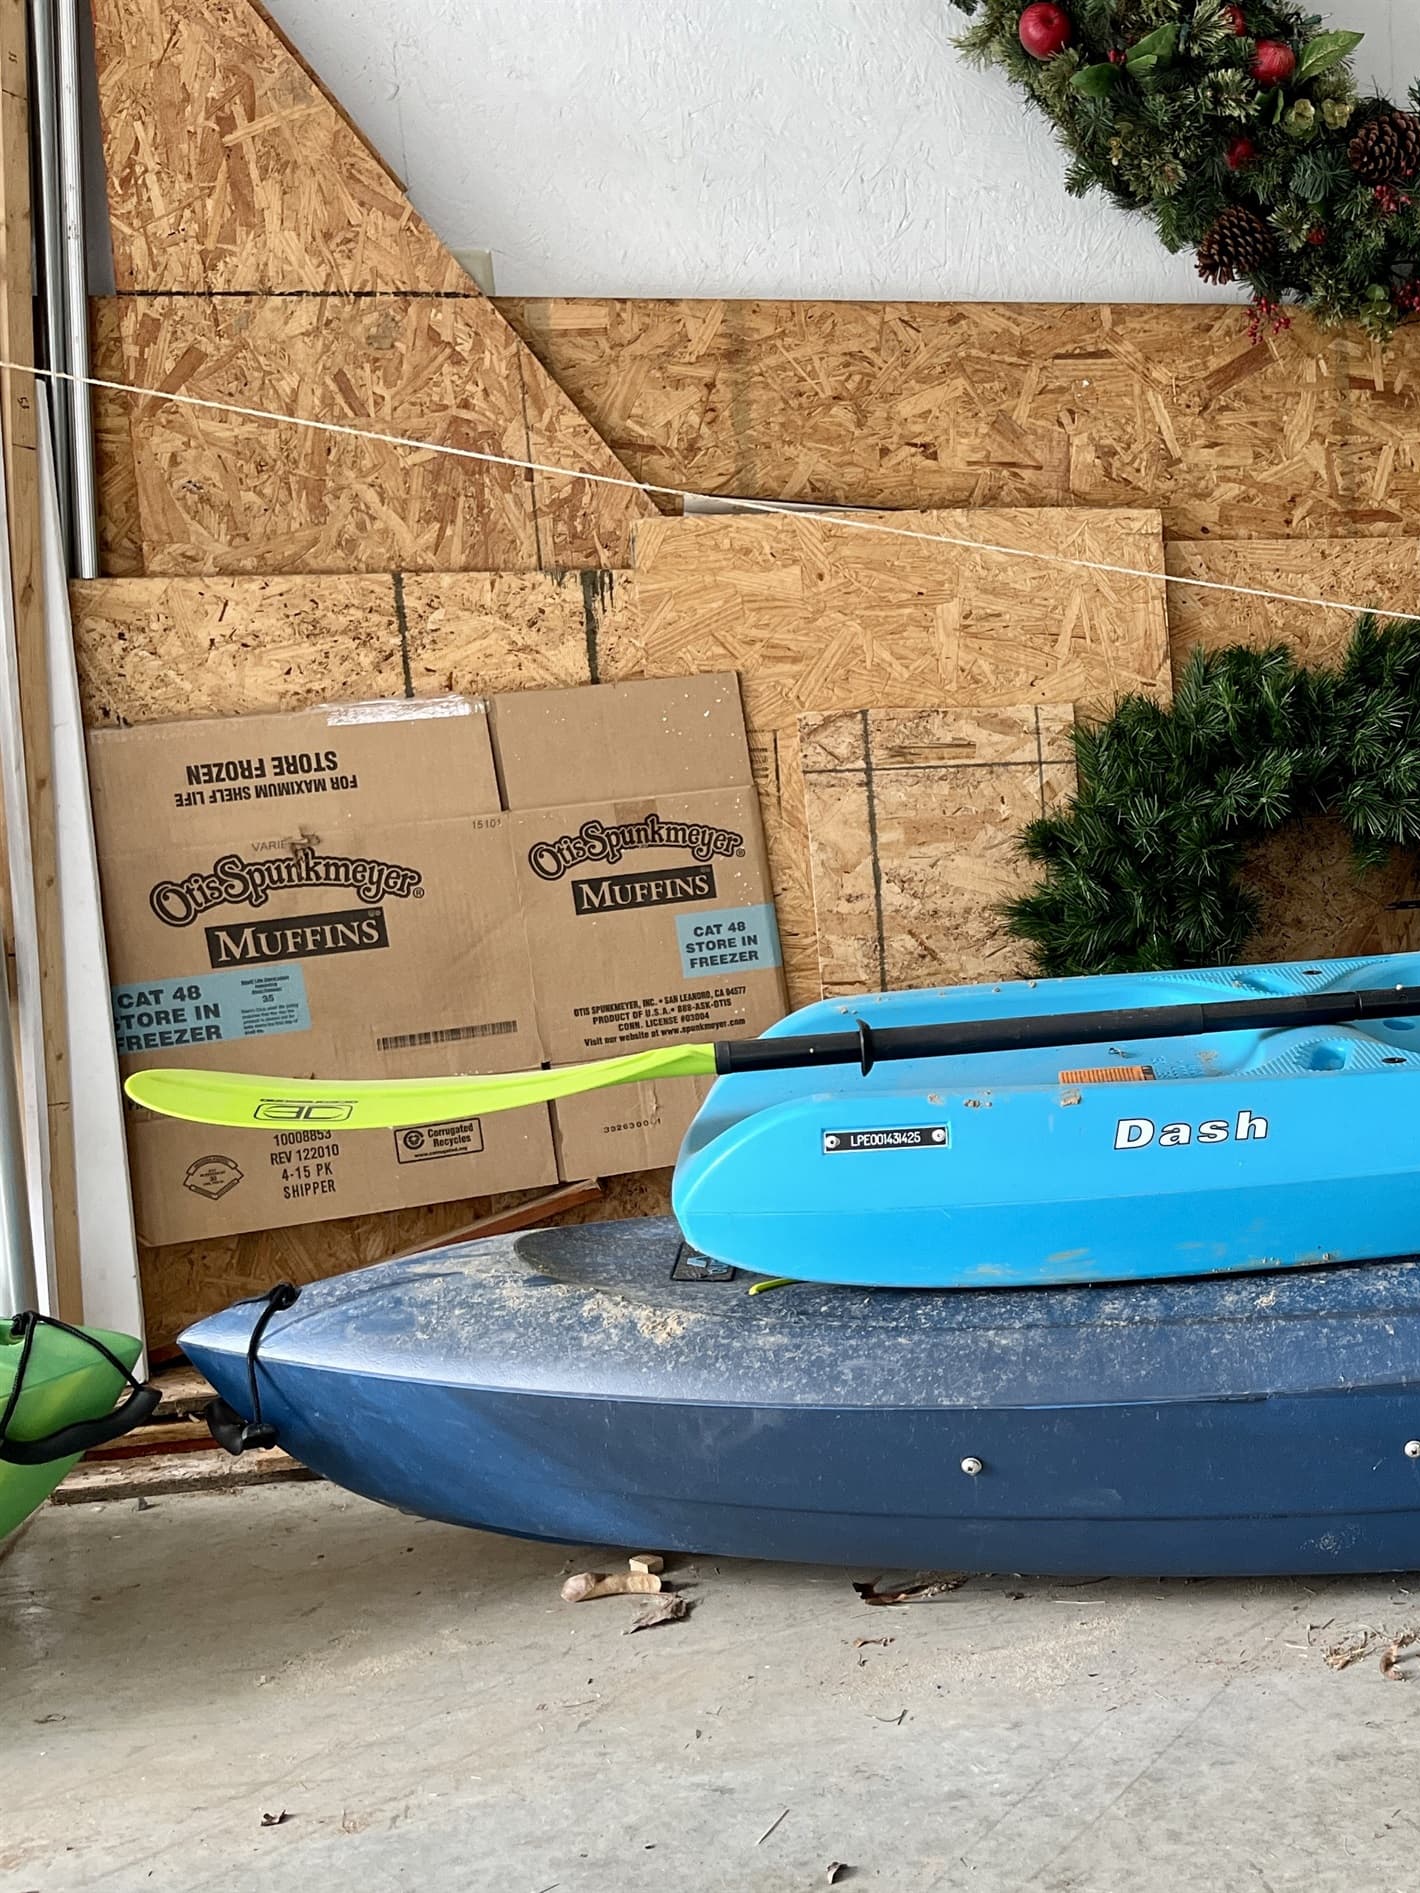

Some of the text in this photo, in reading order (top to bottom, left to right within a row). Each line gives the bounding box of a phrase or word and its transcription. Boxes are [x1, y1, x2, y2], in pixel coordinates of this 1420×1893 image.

[186, 751, 338, 785] STORE FROZEN
[174, 775, 358, 807] FOR MAXIMUM SHELF LIFE
[531, 816, 742, 878] Otis Spunkmeyer
[153, 875, 223, 925] Otis
[579, 875, 710, 910] MUFFINS
[693, 921, 746, 937] CAT 48
[215, 919, 380, 962] MUFFINS
[686, 934, 758, 953] STORE IN
[690, 950, 759, 968] FREEZER
[117, 985, 202, 1009] CAT 48
[574, 1007, 590, 1017] OTIS
[664, 995, 679, 1005] SAN
[714, 988, 725, 998] CA
[194, 1003, 221, 1021] IN
[592, 1011, 630, 1025] PRODUCT
[633, 1009, 643, 1020] OF
[645, 1016, 678, 1028] LICENSE
[584, 1037, 603, 1047] Visit
[604, 1035, 617, 1044] our
[619, 1031, 650, 1042] website
[428, 1123, 474, 1138] Corrugated
[1114, 1110, 1269, 1150] Dash
[433, 1134, 472, 1147] Recycles
[270, 1144, 340, 1165] REV 122010
[282, 1162, 334, 1181] 4-15 PK
[283, 1179, 336, 1199] SHIPPER
